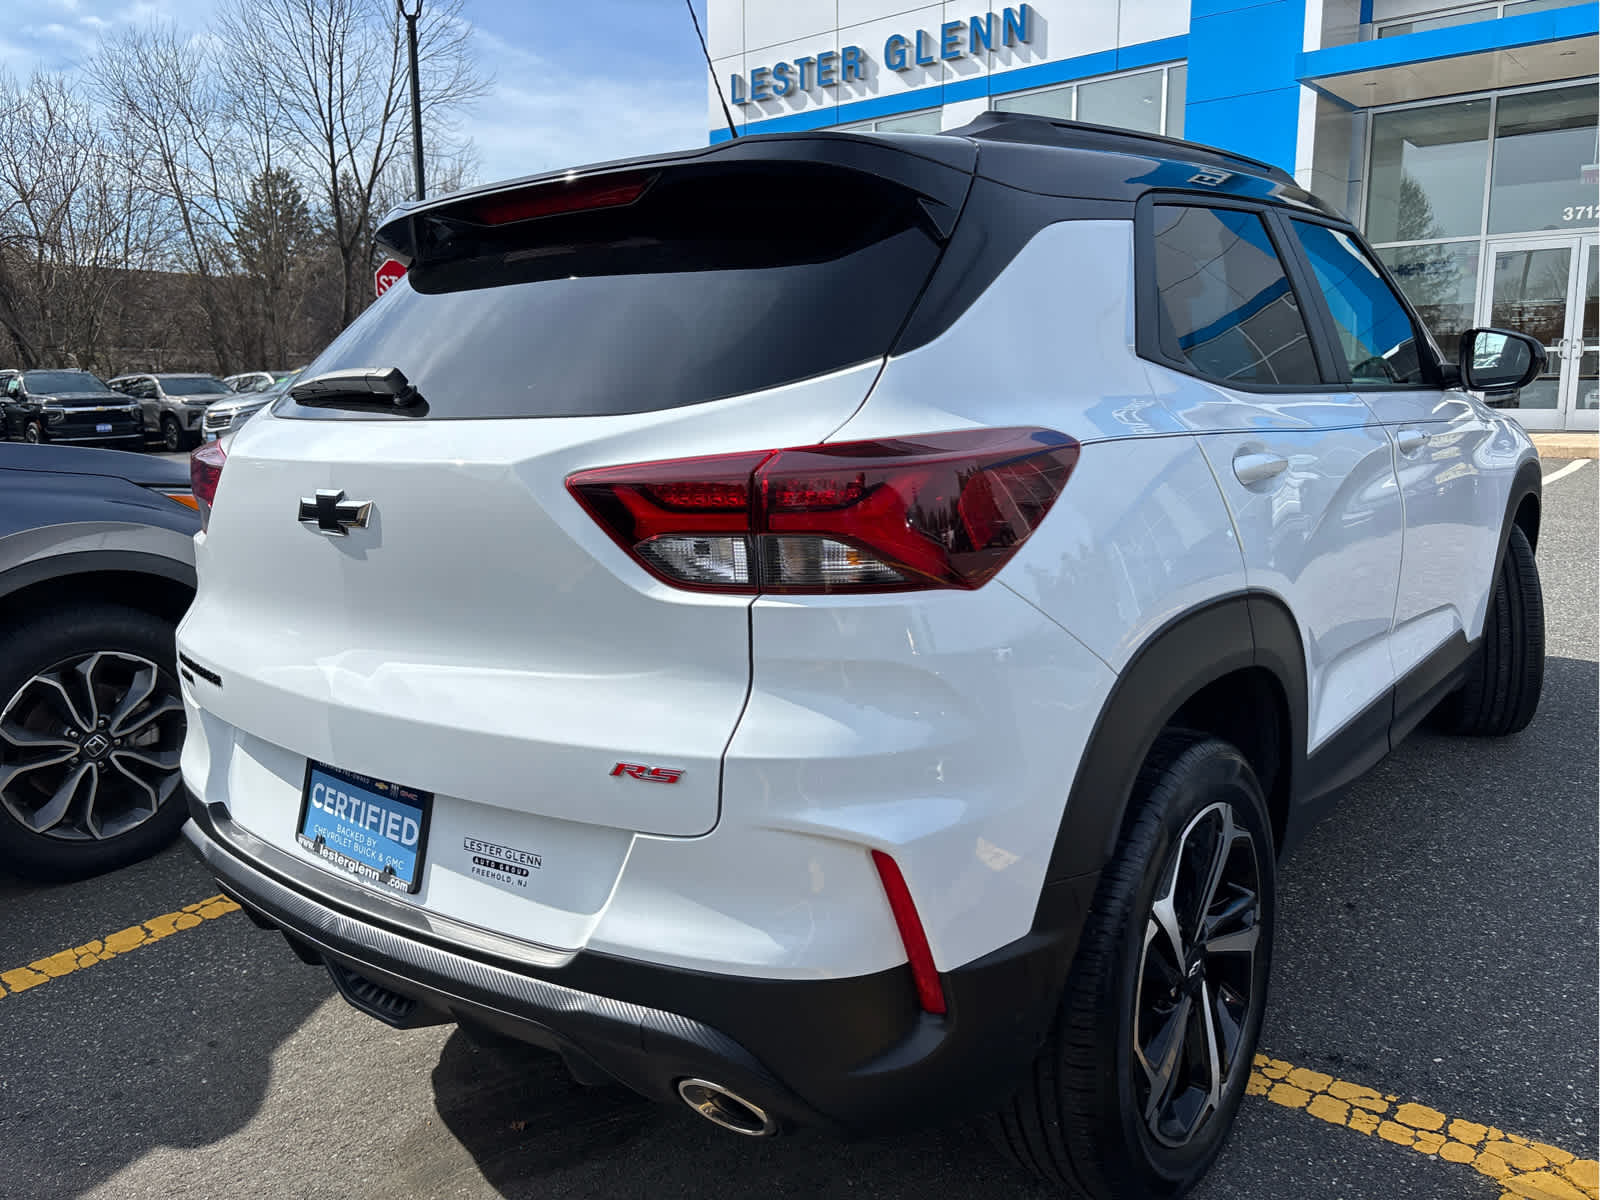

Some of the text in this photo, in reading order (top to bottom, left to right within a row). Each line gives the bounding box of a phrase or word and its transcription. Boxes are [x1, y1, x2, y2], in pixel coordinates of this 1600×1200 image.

[731, 3, 1030, 105] LESTER GLENN
[609, 762, 683, 784] RS
[311, 782, 419, 847] CERTIFIED
[313, 824, 352, 848] CHEVROLET
[353, 842, 377, 860] BUICK
[385, 855, 405, 870] GMC
[337, 824, 377, 847] BACKED BY
[463, 839, 542, 867] LESTER GLENN
[471, 866, 528, 888] FREEHOLD, NJ
[474, 857, 528, 876] AUTO GROUP
